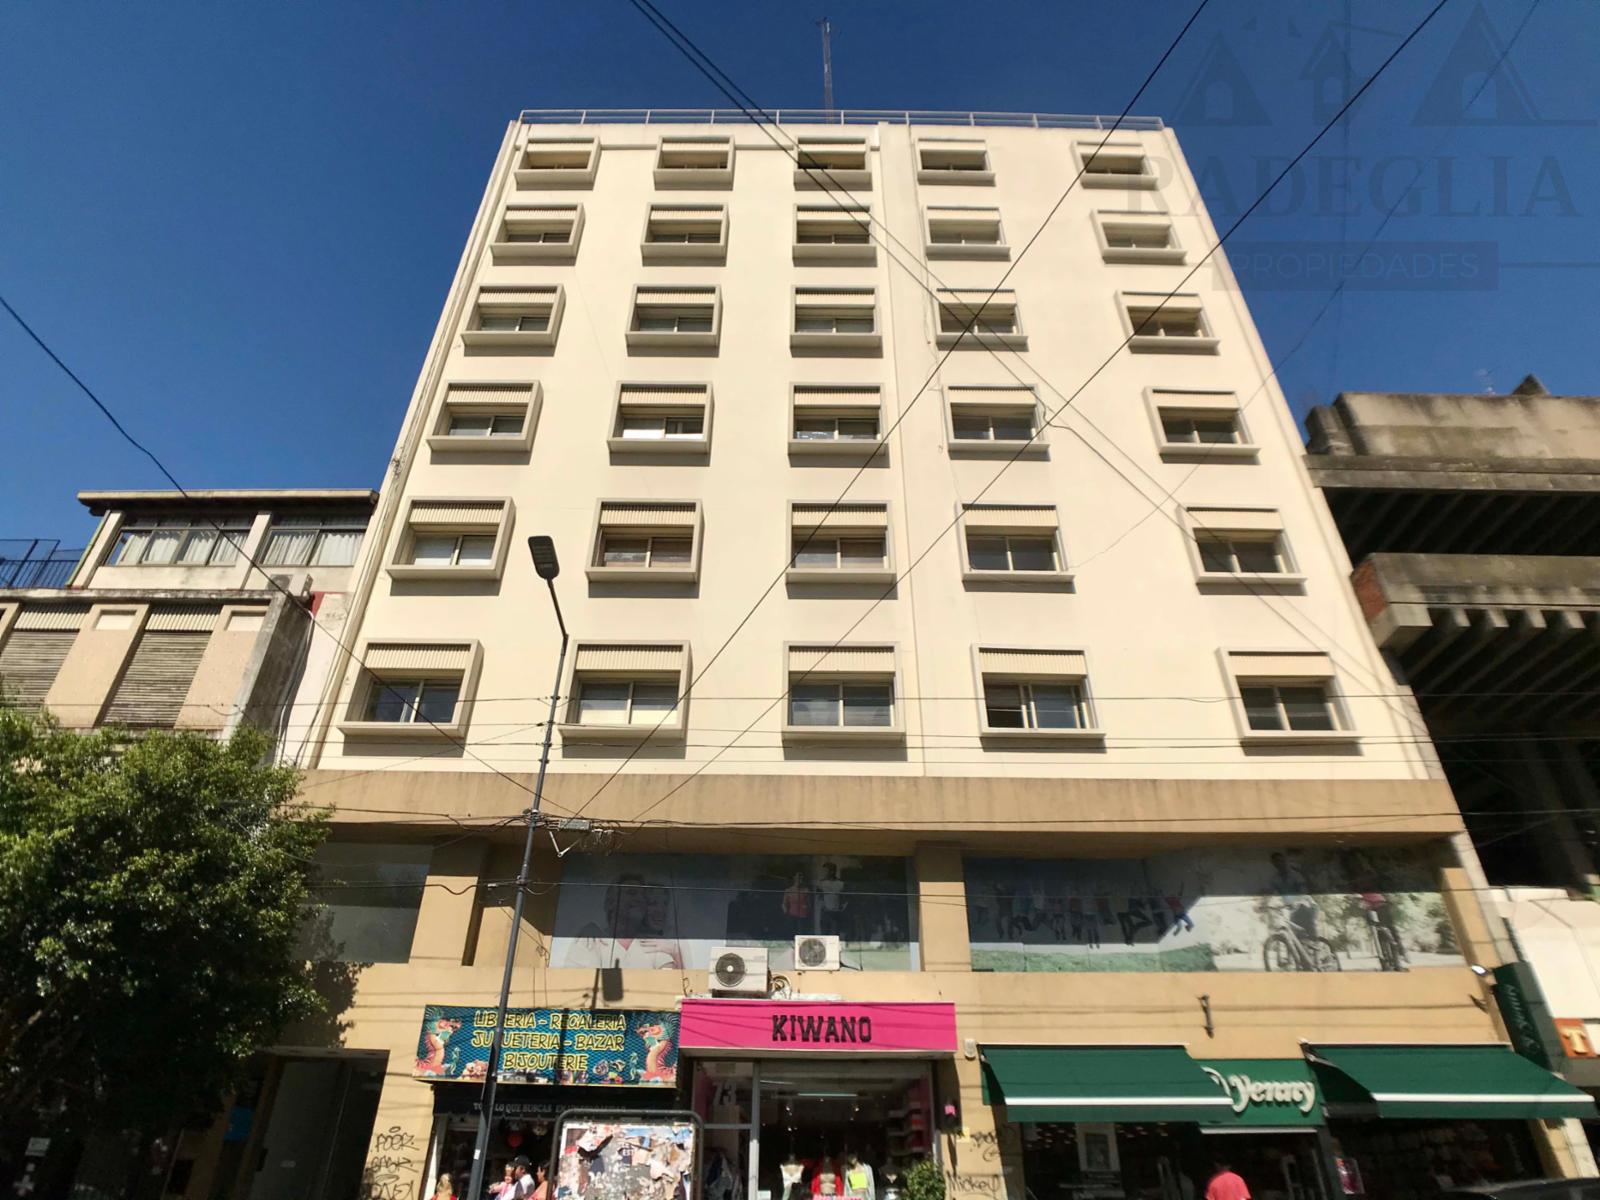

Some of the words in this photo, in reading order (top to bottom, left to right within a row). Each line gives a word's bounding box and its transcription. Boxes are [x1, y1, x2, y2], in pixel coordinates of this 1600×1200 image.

[474, 1010, 536, 1028] LIBERIA
[550, 1012, 626, 1030] REGALERIA
[772, 1014, 872, 1043] KIWANO
[471, 1029, 561, 1050] JUUETERIA
[575, 1034, 625, 1051] BAZAR
[503, 1051, 589, 1070] BIJOUTERIE
